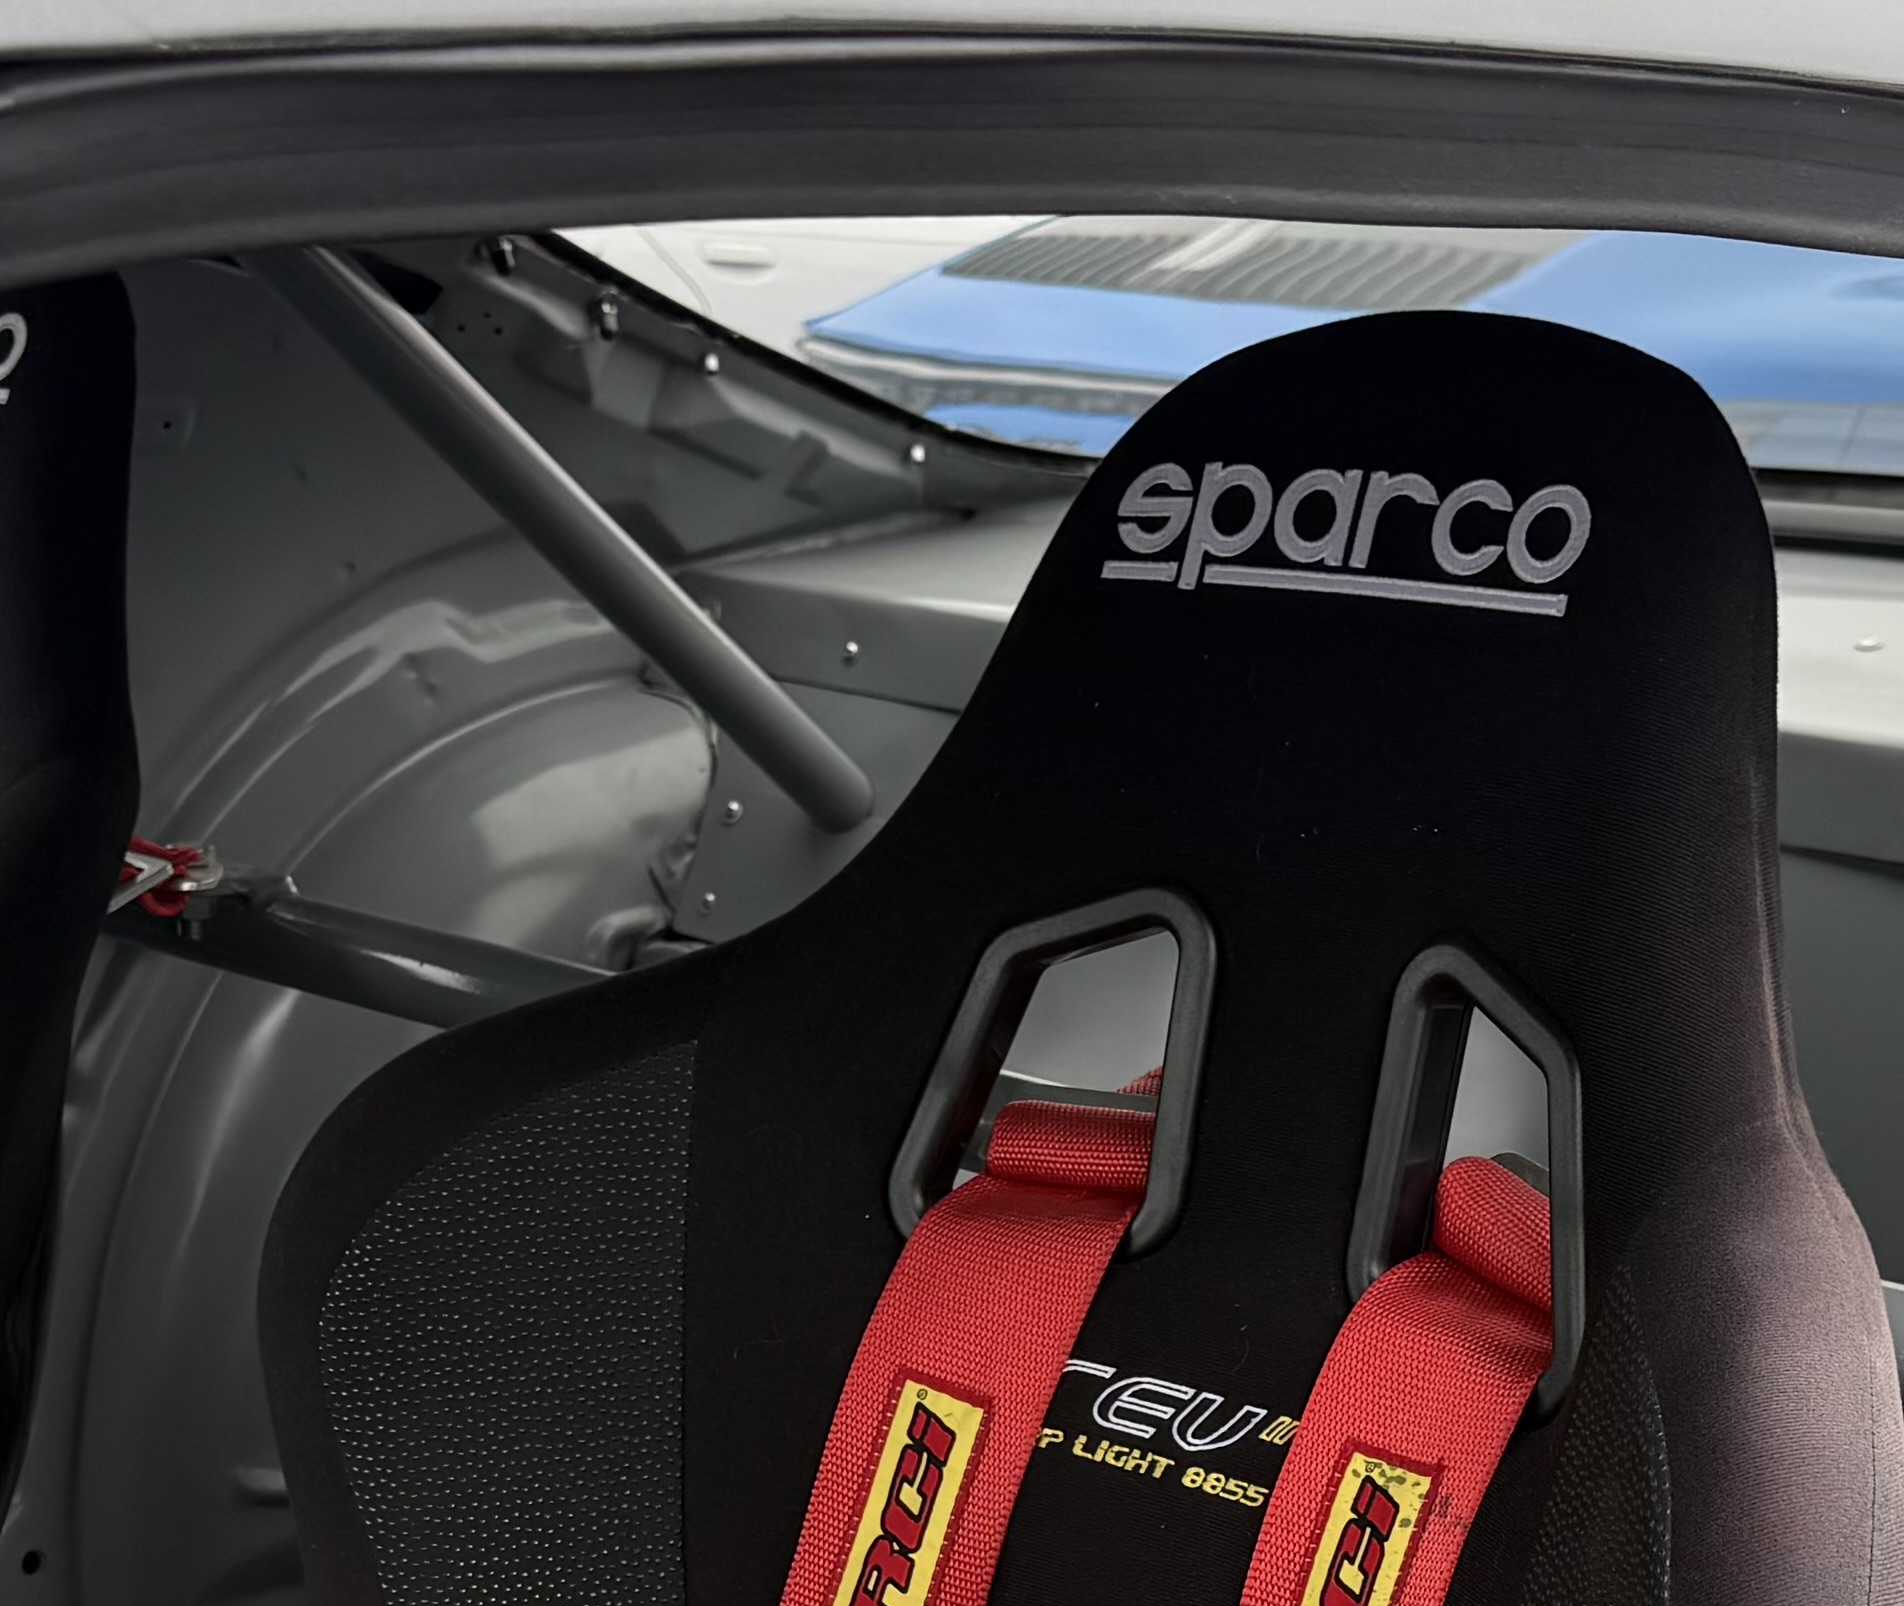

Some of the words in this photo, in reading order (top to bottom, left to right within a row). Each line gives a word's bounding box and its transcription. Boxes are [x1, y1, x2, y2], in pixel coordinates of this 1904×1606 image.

[1101, 460, 1592, 617] sparco
[1072, 1434, 1176, 1479] LIGHT
[1181, 1466, 1269, 1507] 8855
